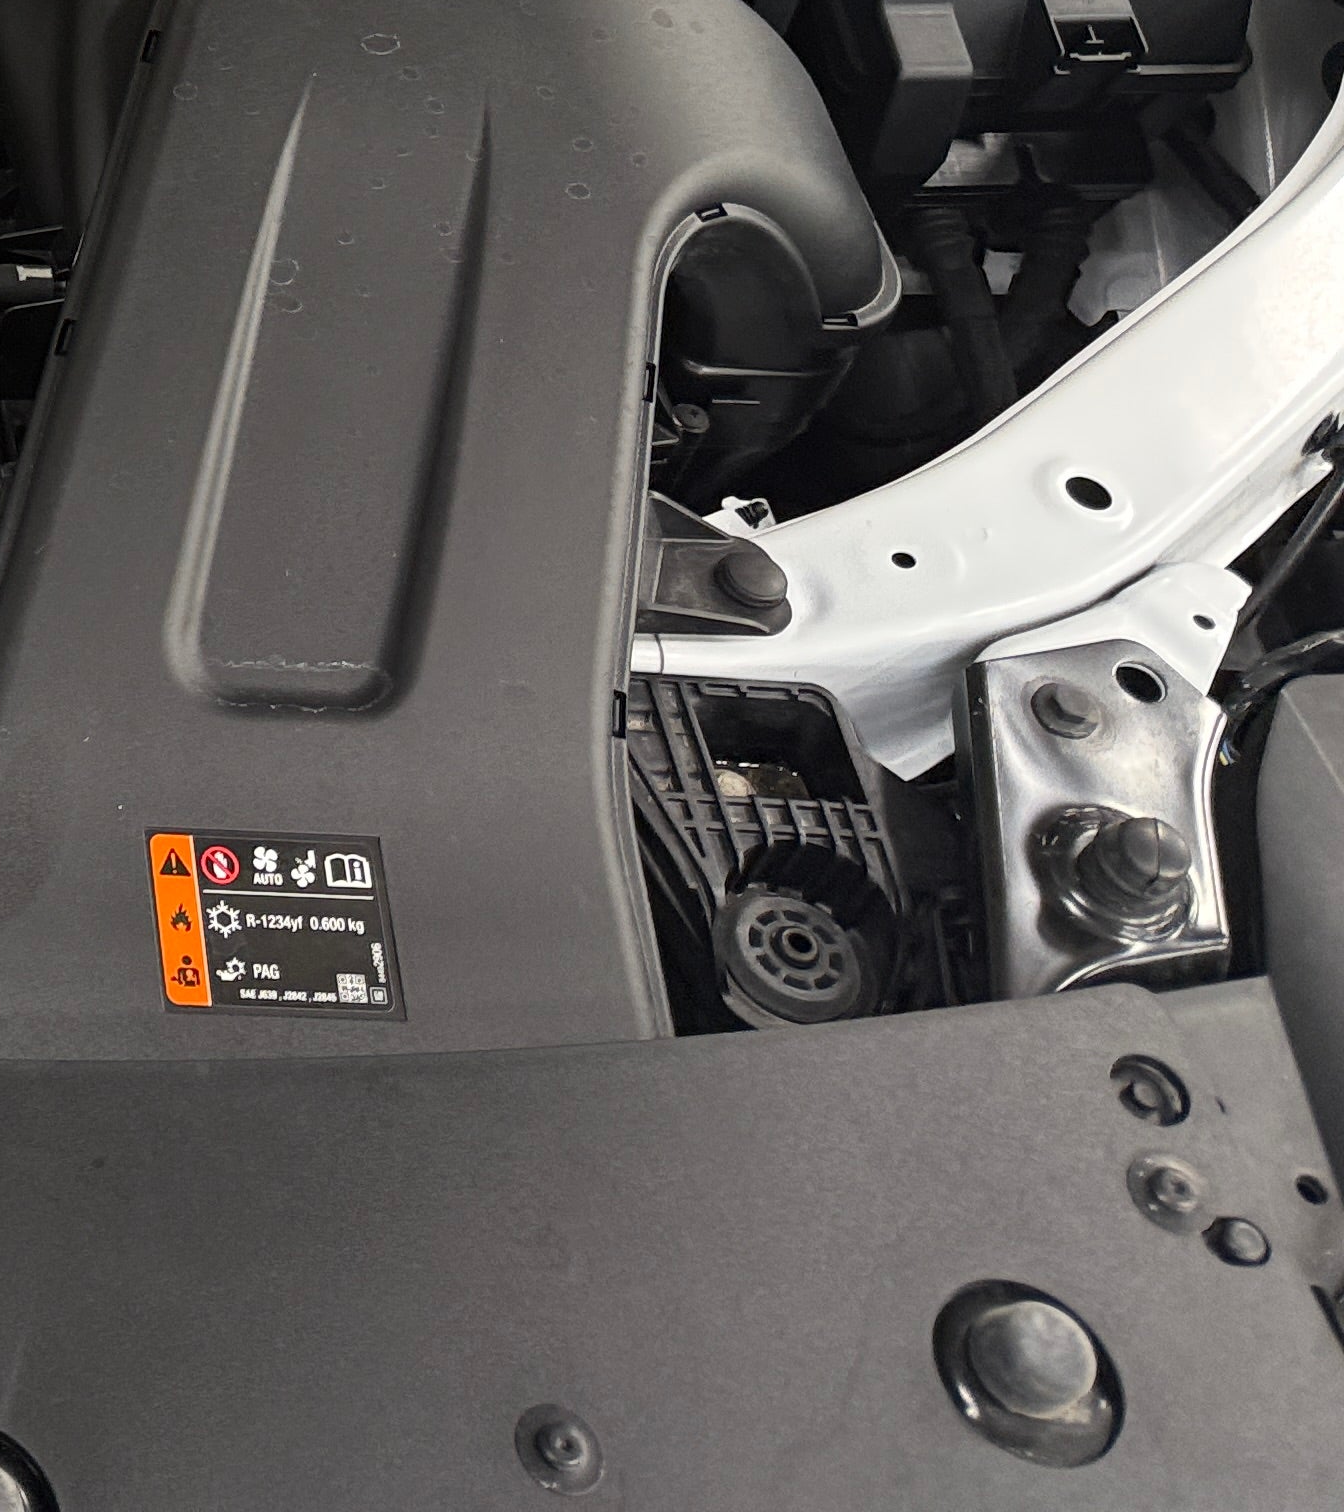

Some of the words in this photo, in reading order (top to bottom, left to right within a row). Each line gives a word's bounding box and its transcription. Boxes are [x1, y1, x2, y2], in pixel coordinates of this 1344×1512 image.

[253, 873, 283, 886] AUTO
[246, 913, 303, 934] R-1234yf
[309, 917, 345, 932] 0.600
[348, 918, 365, 935] kg
[252, 963, 280, 981] PAG
